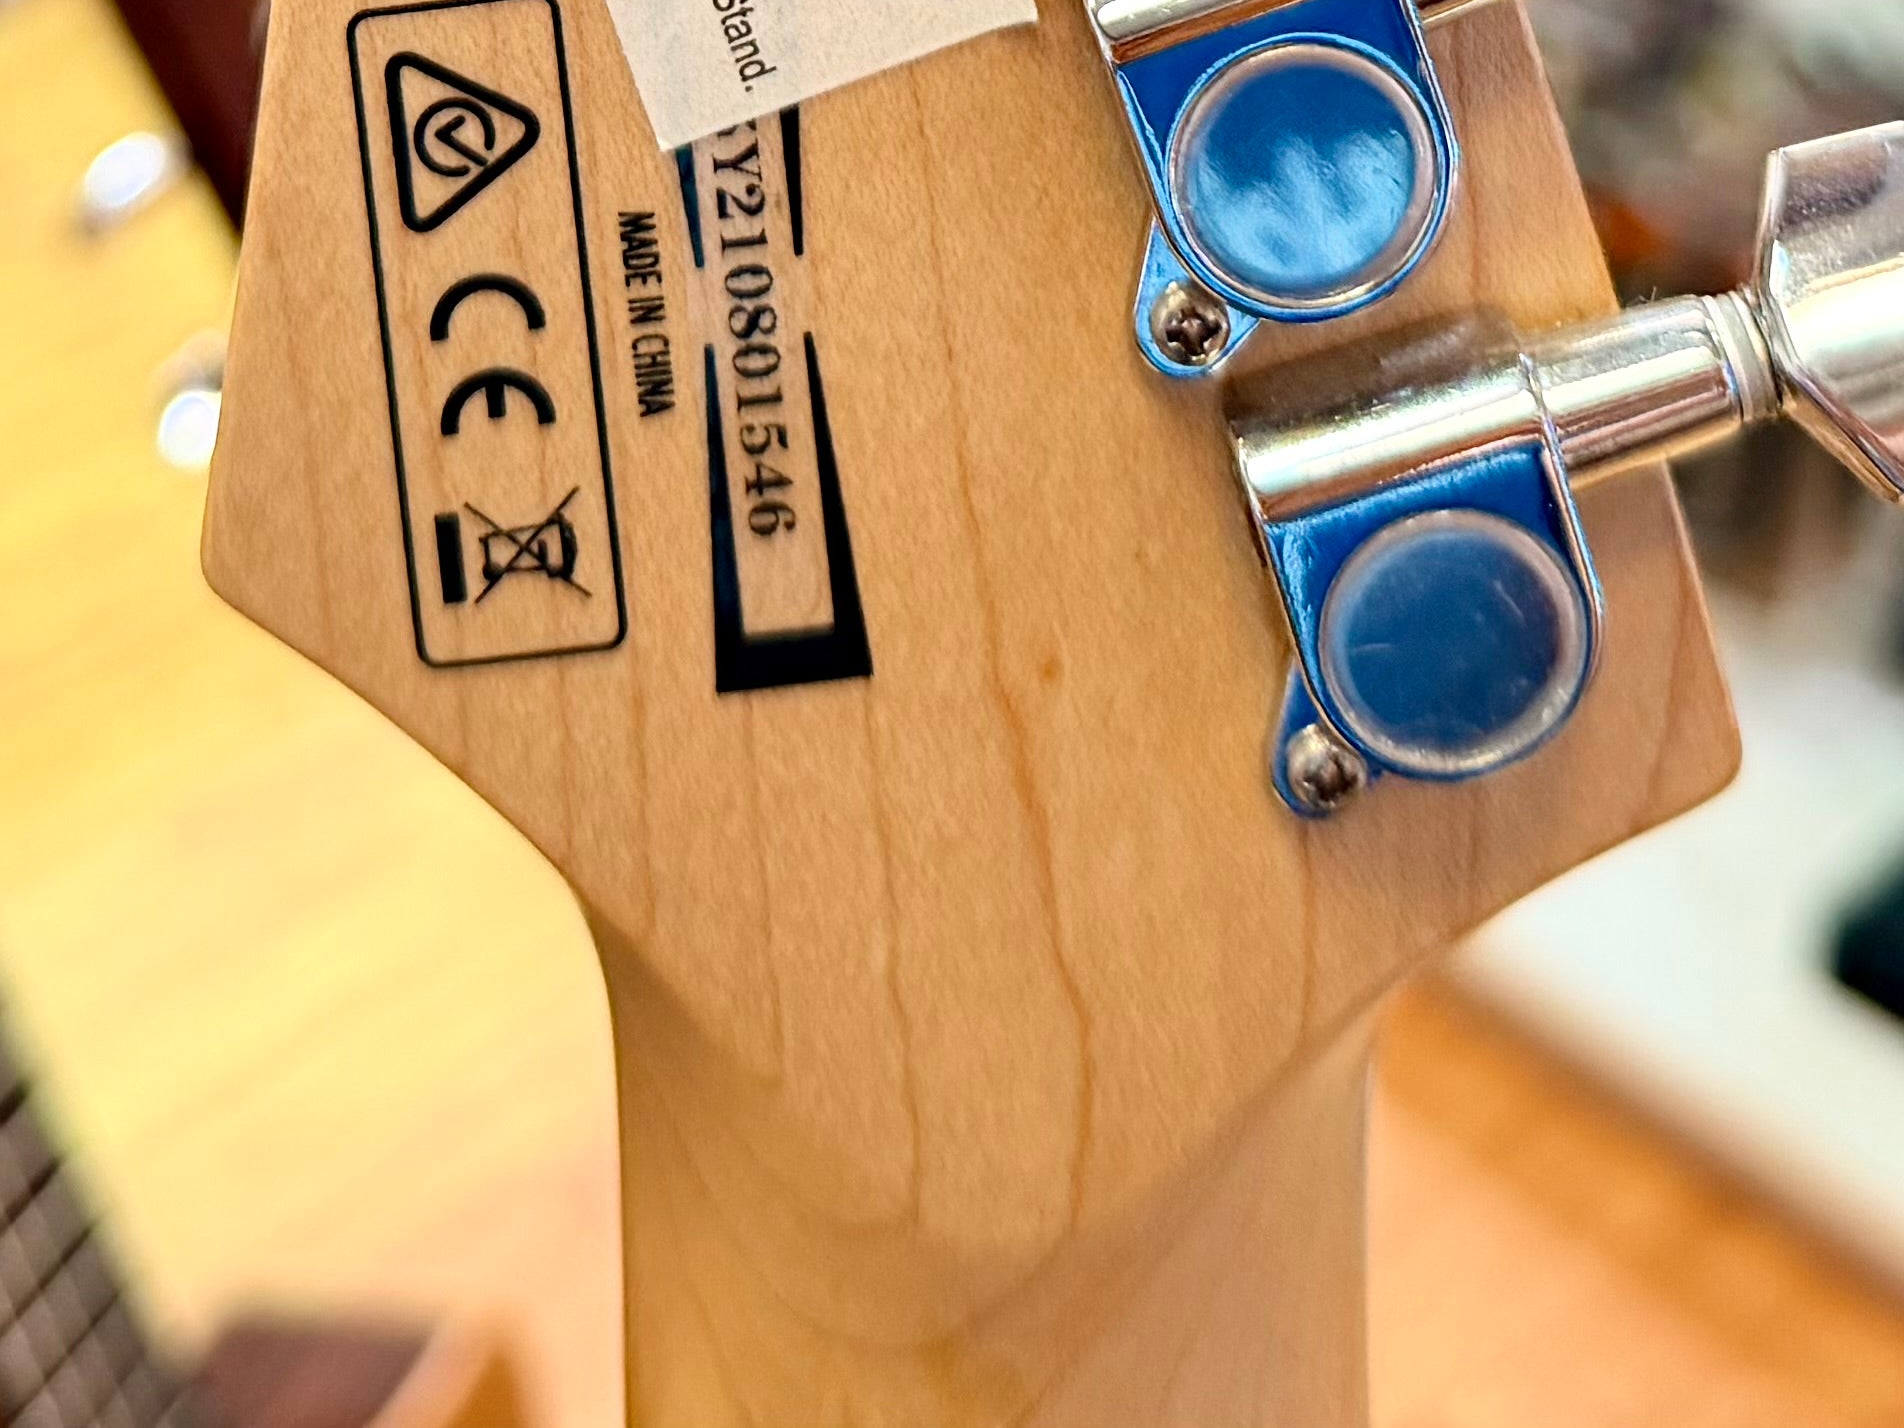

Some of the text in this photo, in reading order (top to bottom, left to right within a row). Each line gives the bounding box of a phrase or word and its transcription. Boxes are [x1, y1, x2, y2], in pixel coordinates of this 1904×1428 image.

[617, 211, 675, 418] MADE IN CHINA
